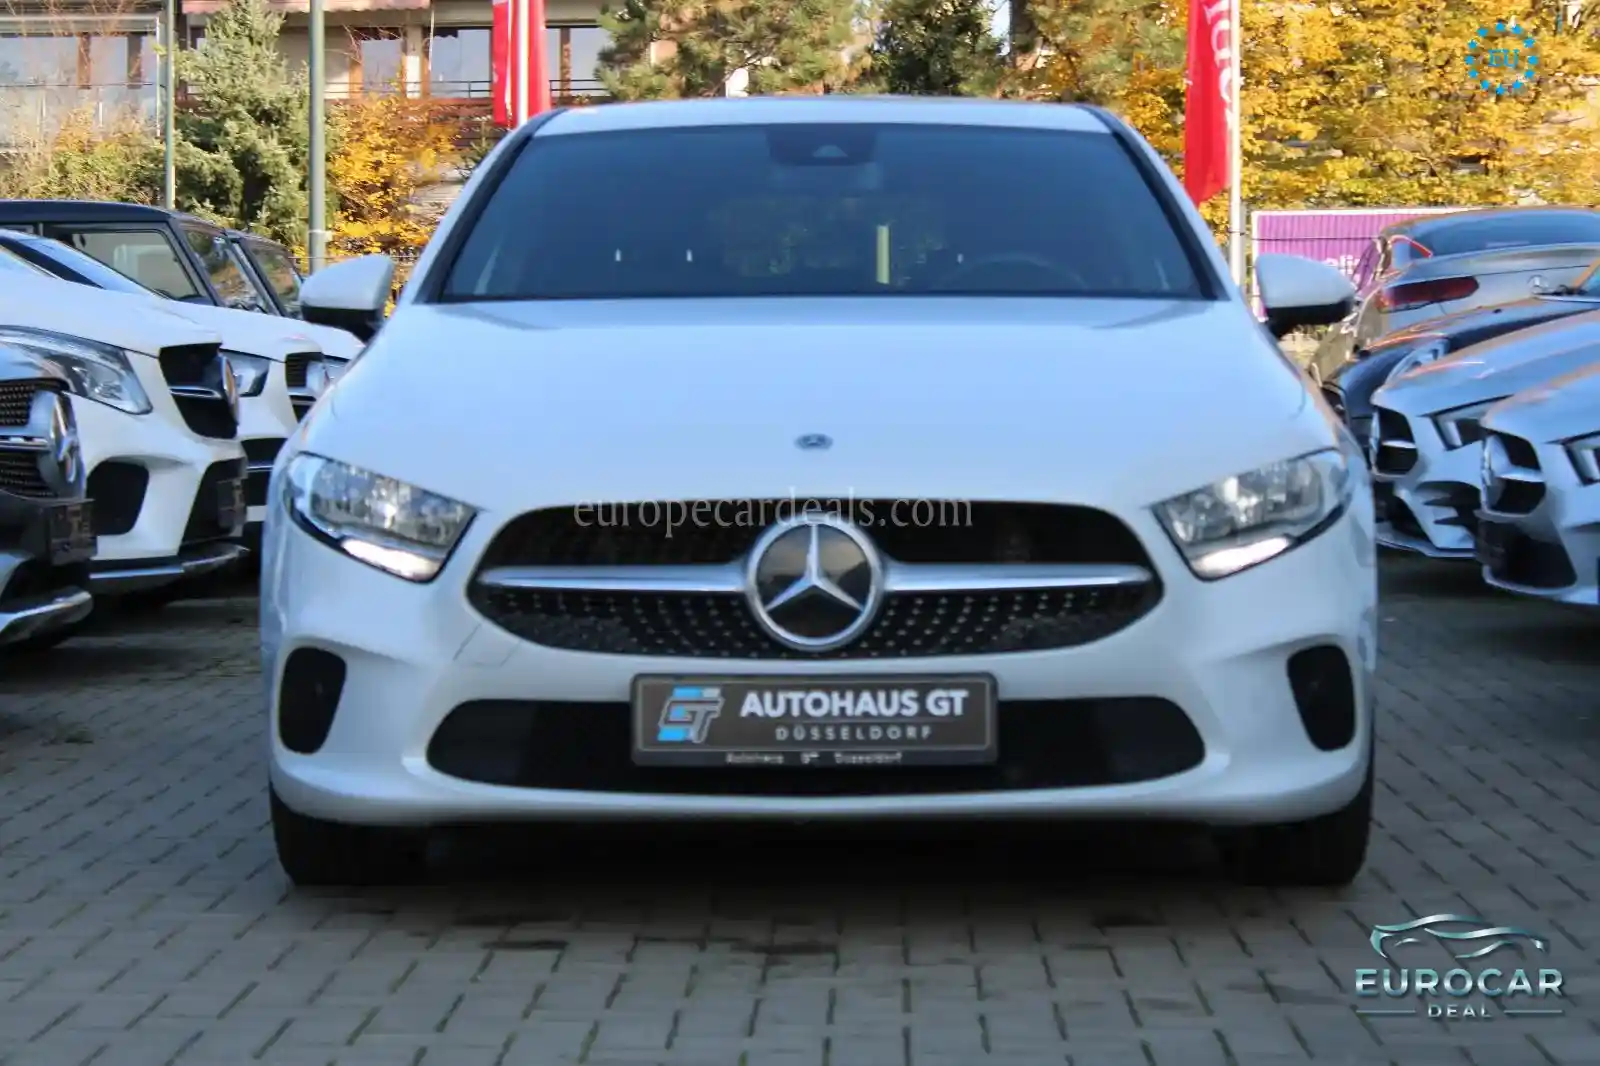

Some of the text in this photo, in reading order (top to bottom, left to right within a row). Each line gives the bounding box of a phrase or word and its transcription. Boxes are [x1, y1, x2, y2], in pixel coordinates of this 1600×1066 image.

[740, 689, 969, 717] AUTOHAUS GT
[775, 725, 932, 741] DÜSSELDORF
